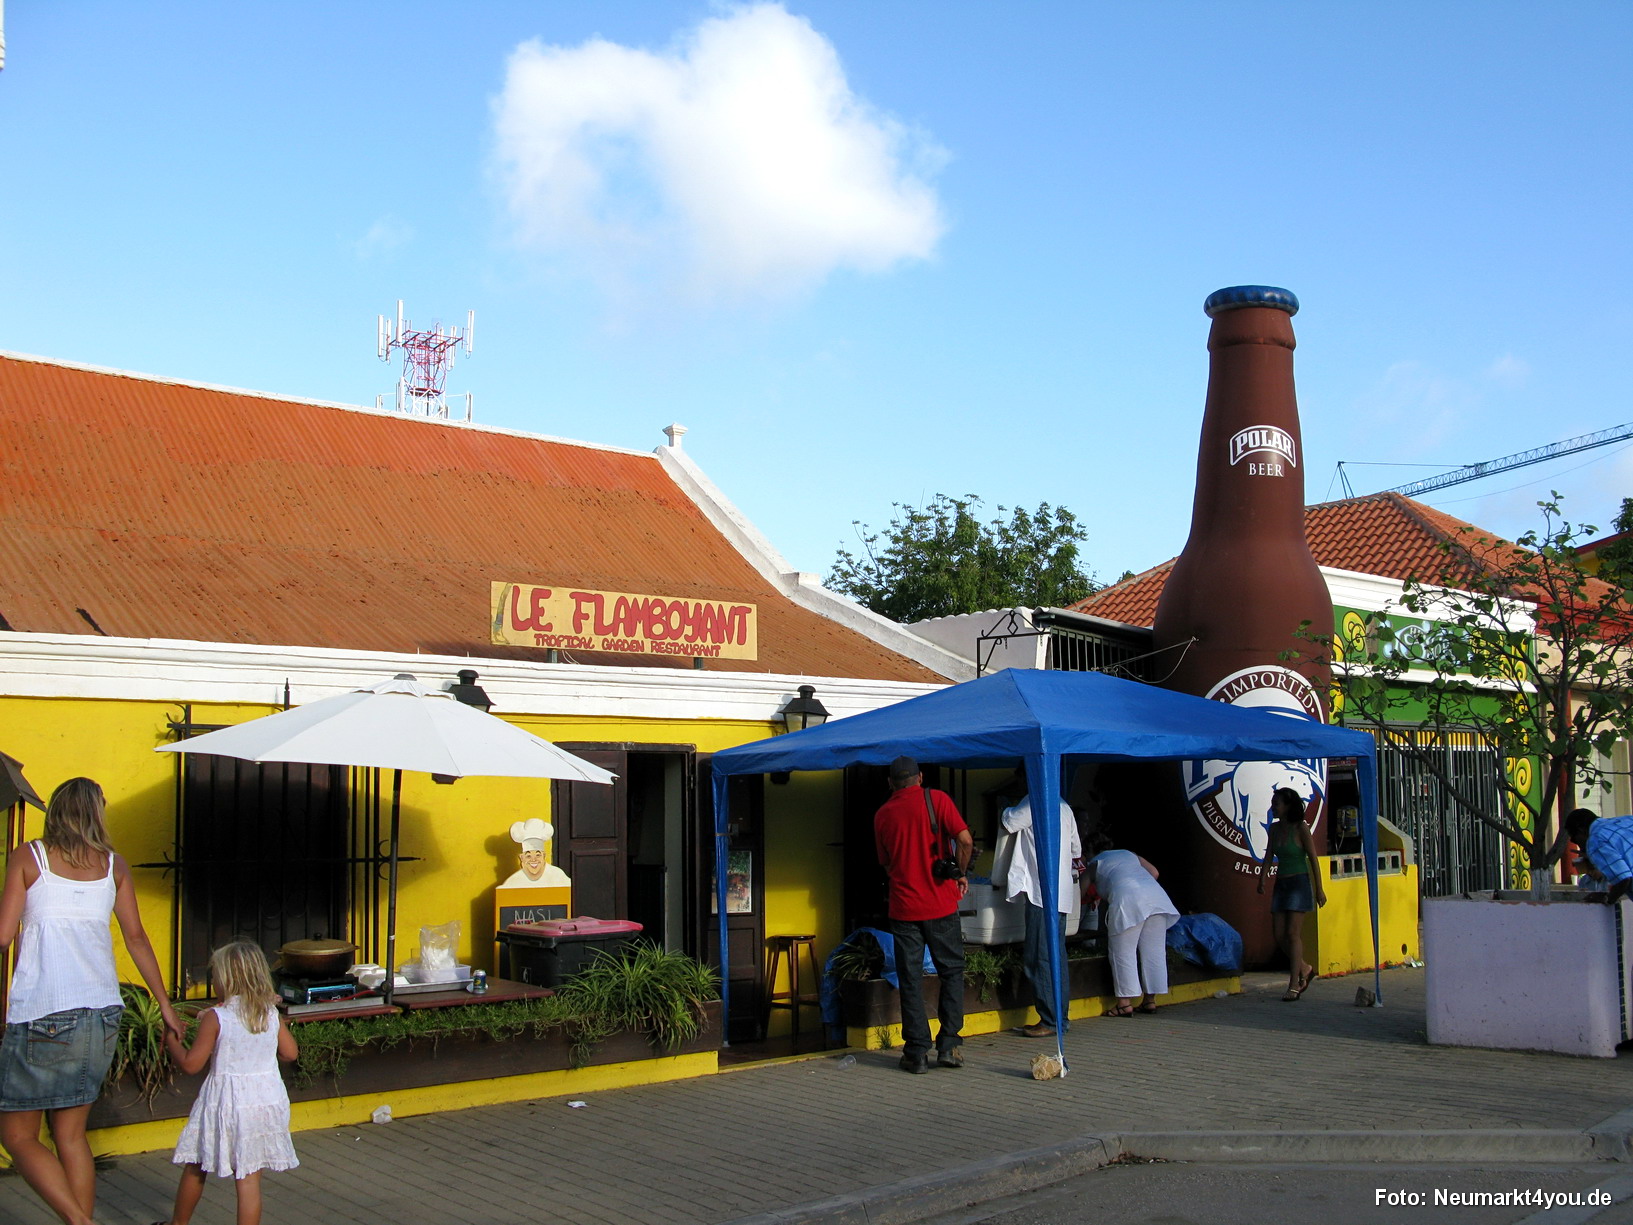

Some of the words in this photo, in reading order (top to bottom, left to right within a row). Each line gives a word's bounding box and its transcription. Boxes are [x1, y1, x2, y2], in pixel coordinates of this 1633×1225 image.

[1234, 429, 1293, 459] POLAR
[1248, 462, 1285, 478] BEER
[511, 585, 553, 631] LE
[569, 591, 752, 646] FLAMBOYANT
[534, 633, 595, 650] TROPICAL
[601, 639, 645, 653] GARDEN
[651, 641, 721, 657] RESTAURANT
[1221, 671, 1313, 709] IMPORTED
[1202, 801, 1243, 845] PILSENER
[1234, 861, 1241, 871] 8
[1241, 863, 1253, 875] FL.
[514, 908, 551, 925] NASI
